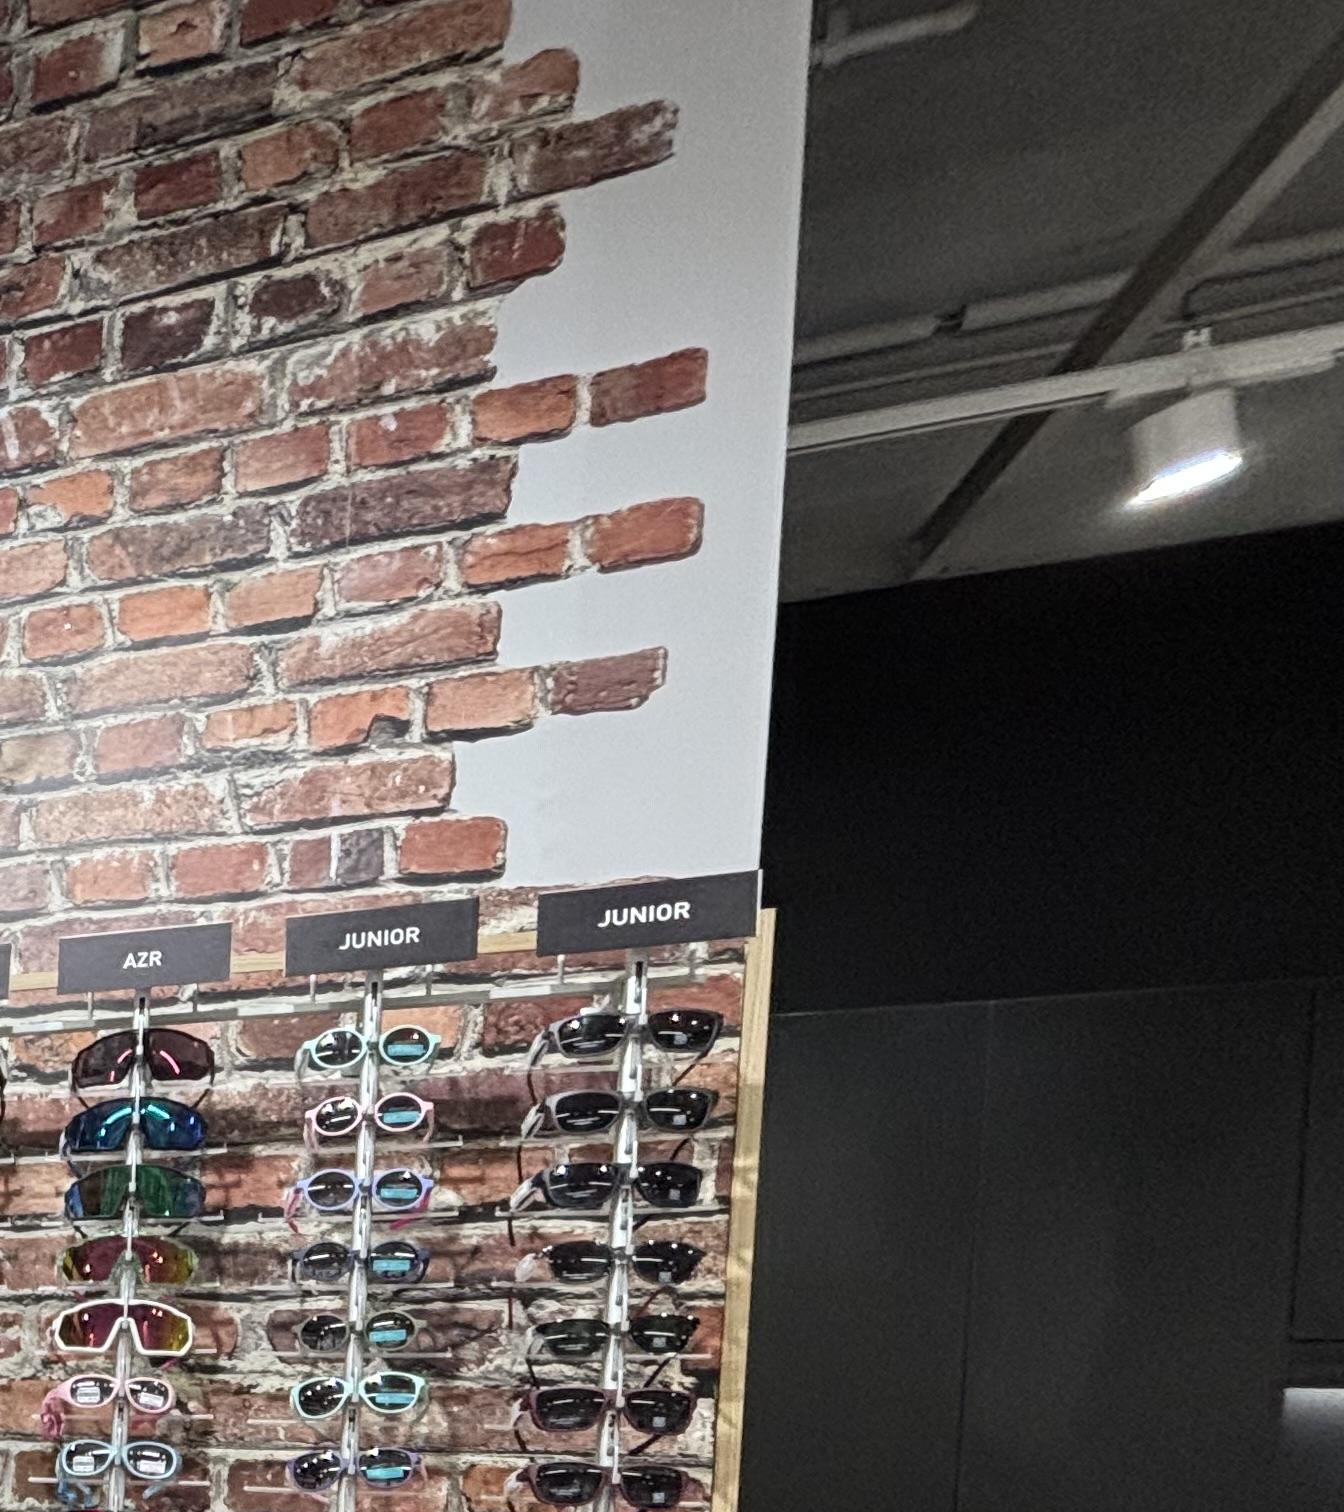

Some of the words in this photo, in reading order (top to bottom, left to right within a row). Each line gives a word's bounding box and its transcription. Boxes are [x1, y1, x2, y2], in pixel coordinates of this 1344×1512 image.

[597, 900, 692, 929] JUNIOR
[337, 924, 421, 951] JUNIOR
[122, 948, 163, 970] AZR
